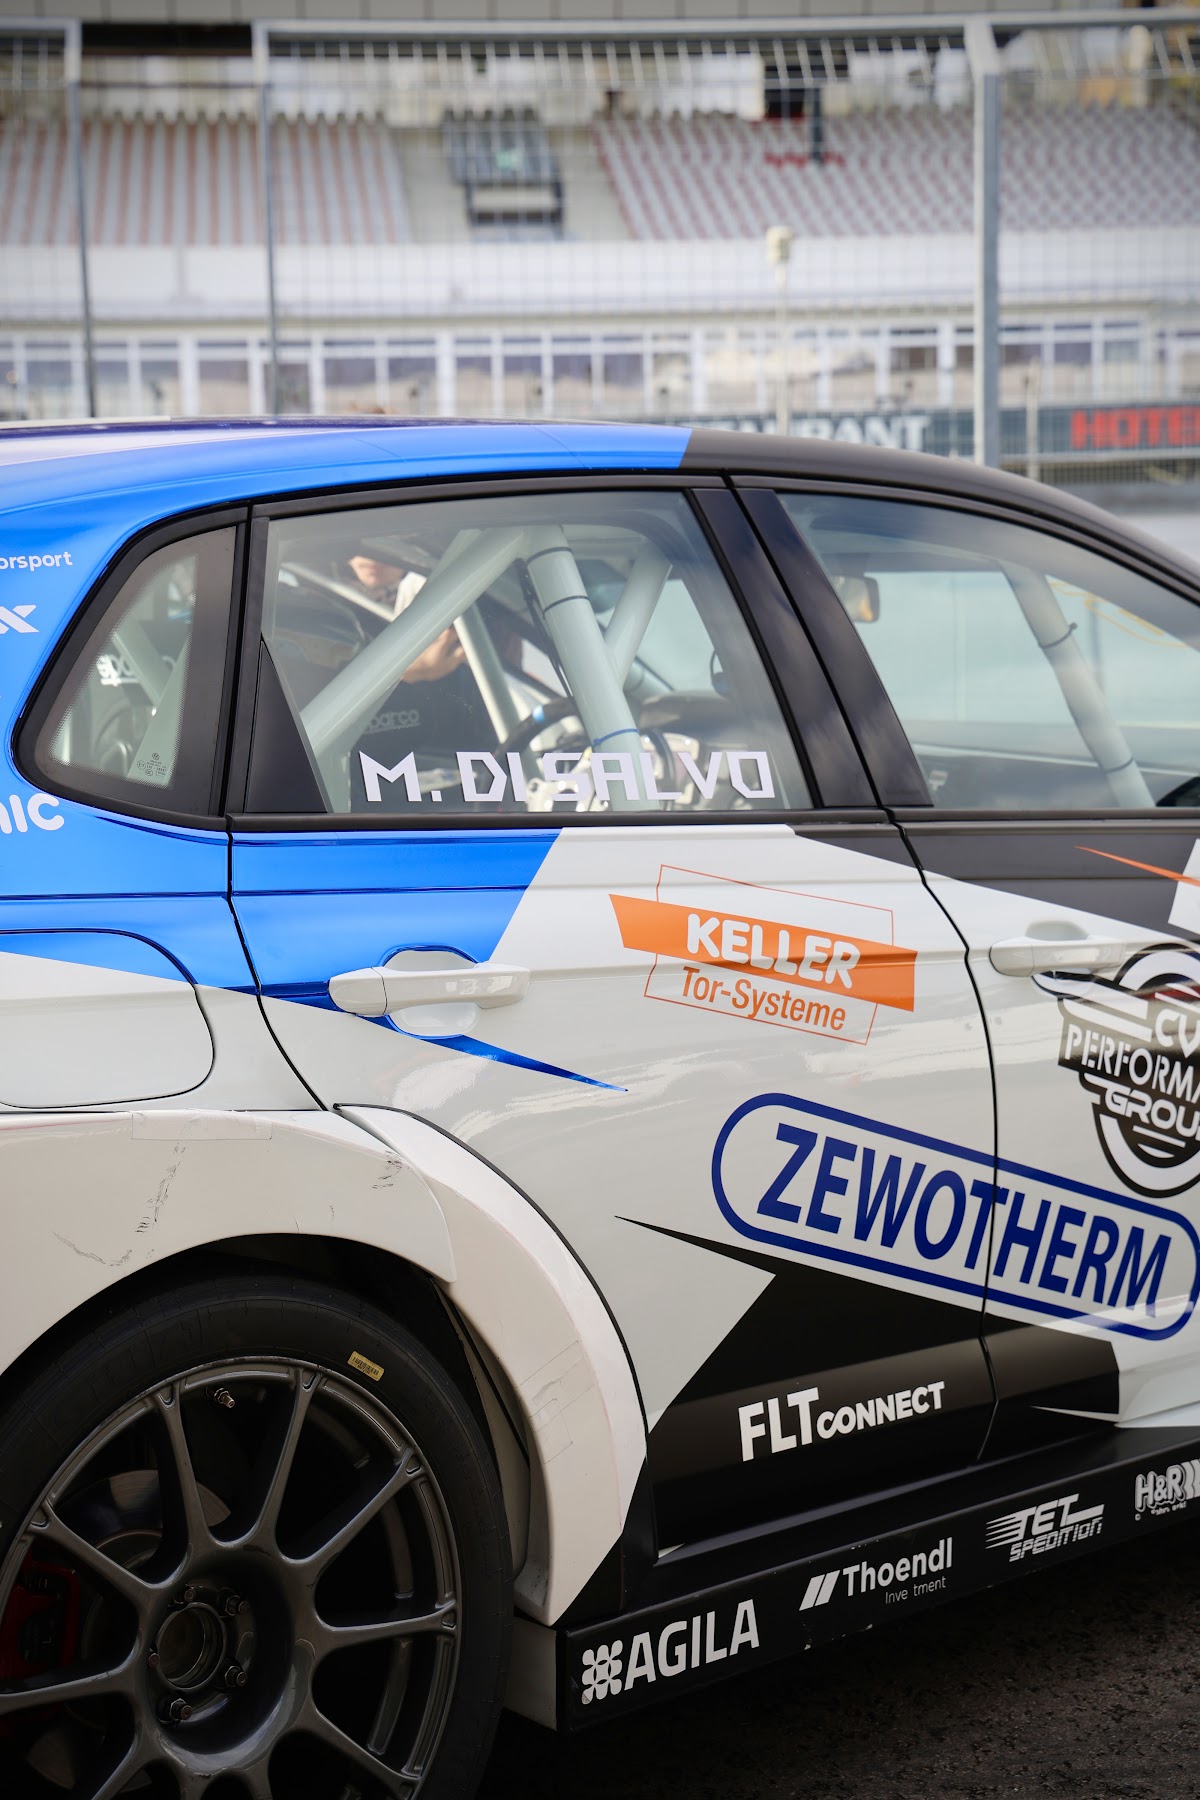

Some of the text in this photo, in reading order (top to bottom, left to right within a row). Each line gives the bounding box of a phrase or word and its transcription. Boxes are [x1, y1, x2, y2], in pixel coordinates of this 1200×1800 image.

[364, 708, 421, 733] parco
[359, 750, 442, 802] M.
[687, 913, 861, 989] KELLER
[682, 965, 847, 1031] Tor-Systeme
[1104, 1086, 1200, 1141] GROU
[756, 1121, 1172, 1318] ZEWOTHERM
[738, 1381, 945, 1462] FLT CONNECT
[1135, 1465, 1186, 1513] H&R
[842, 1537, 953, 1597] Thoendl
[1009, 1516, 1103, 1563] SPEDITION
[624, 1598, 760, 1691] AGILA
